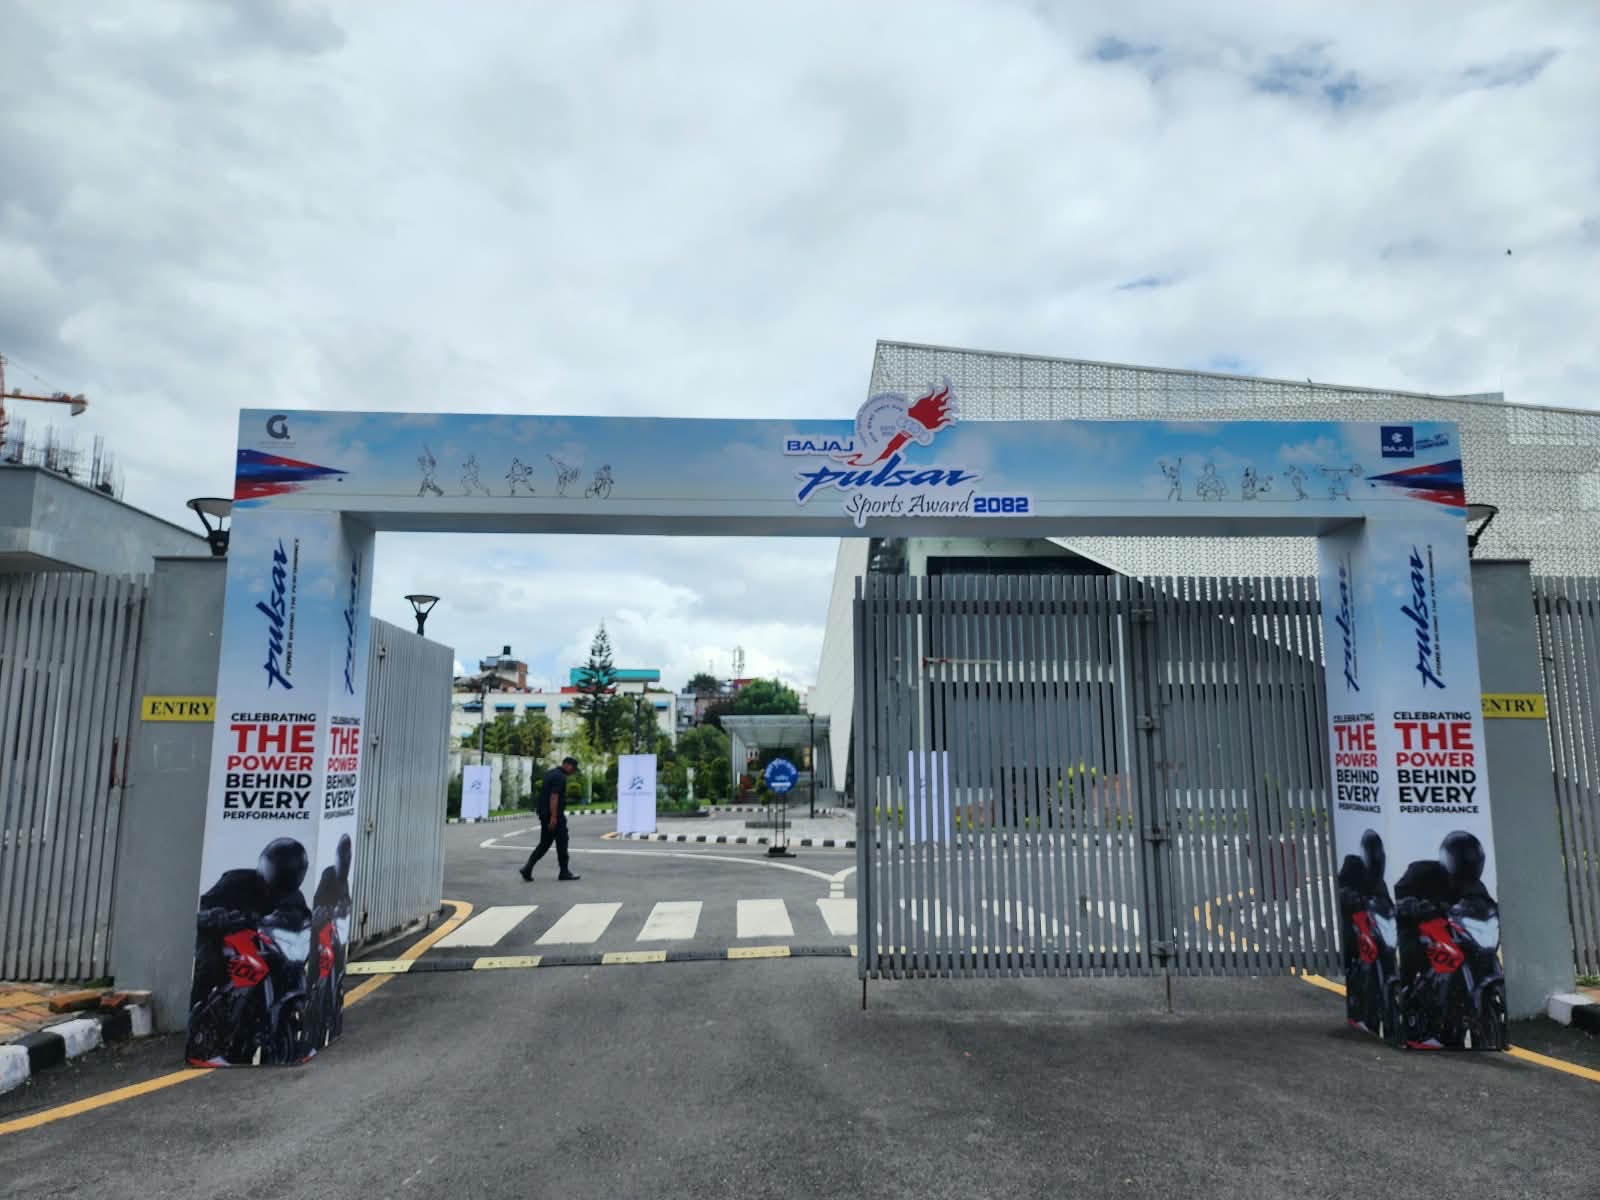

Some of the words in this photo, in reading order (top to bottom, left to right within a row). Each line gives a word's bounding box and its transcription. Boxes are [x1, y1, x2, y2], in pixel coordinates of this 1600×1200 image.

[787, 440, 854, 452] BAJAJ
[799, 454, 979, 500] pulsar
[846, 494, 904, 524] Sports
[908, 490, 975, 513] Award
[974, 497, 1029, 513] 2082
[256, 537, 294, 689] pulsar
[1401, 544, 1446, 689] pulsar
[150, 701, 214, 716] ENTRY
[1393, 711, 1472, 721] CELEBRATING
[231, 712, 316, 722] CELEBRATING
[230, 724, 315, 753] THE
[330, 727, 360, 755] THE
[1333, 724, 1377, 751] THE
[1393, 722, 1474, 750] THE
[227, 755, 314, 771] POWER
[328, 757, 358, 772] POWER
[1335, 753, 1378, 768] POWER
[1396, 752, 1475, 767] POWER
[225, 773, 312, 789] BEHIND
[326, 773, 357, 790] BEHIND
[1336, 769, 1379, 785] BEHIND
[1397, 769, 1476, 784] BEHIND
[224, 791, 311, 809] EVERY
[324, 790, 356, 810] EVERY
[1337, 785, 1380, 803] EVERY
[1398, 786, 1477, 803] EVERY
[223, 811, 310, 820] PERFORMANCE
[1400, 805, 1479, 814] PERFORMANCE
